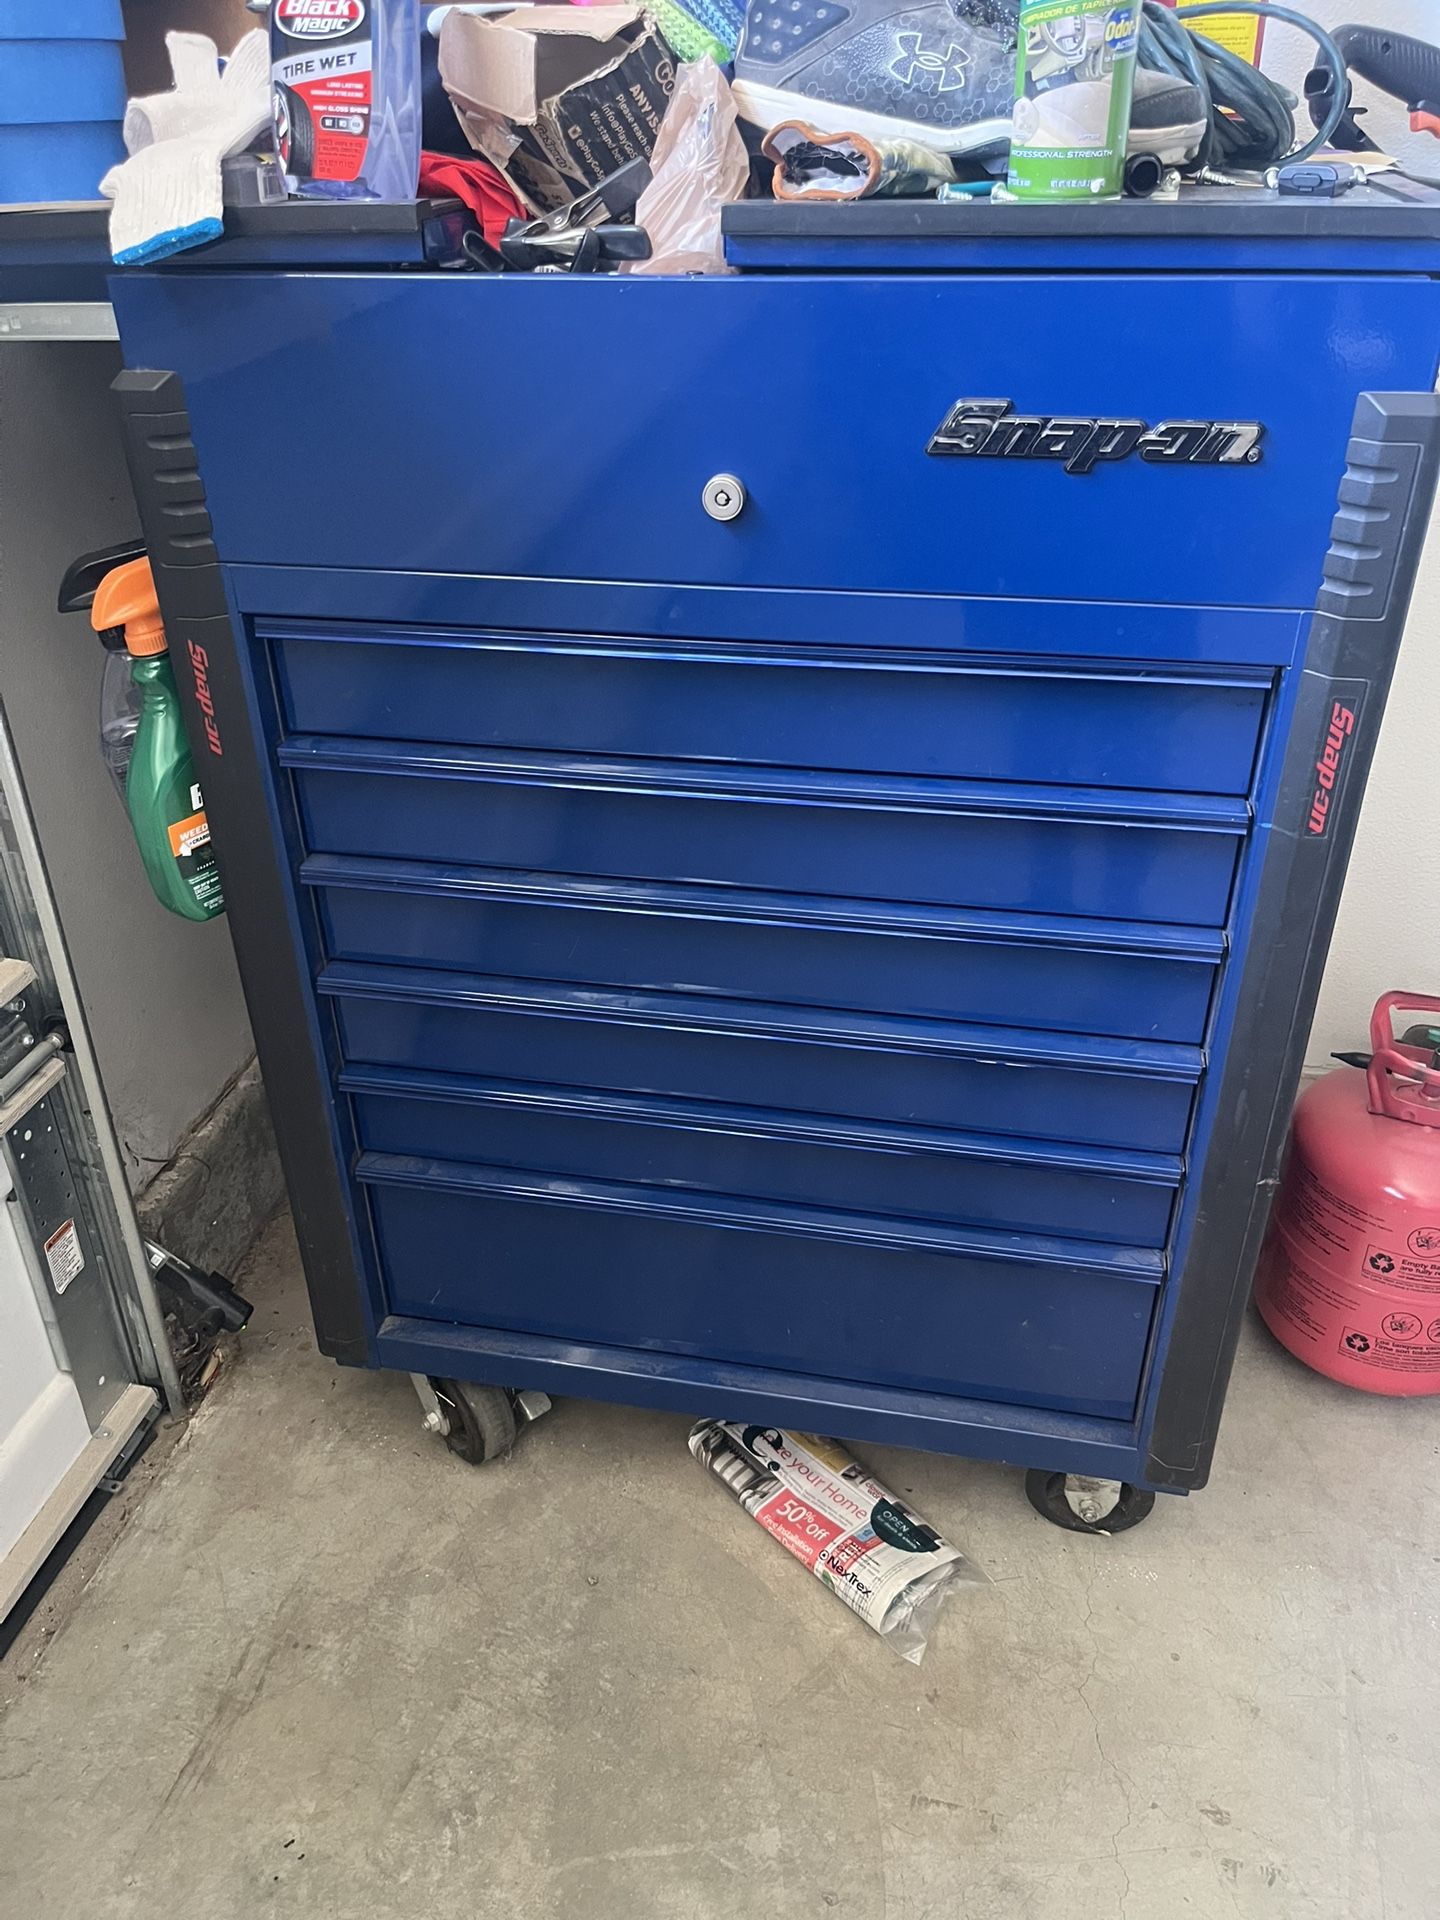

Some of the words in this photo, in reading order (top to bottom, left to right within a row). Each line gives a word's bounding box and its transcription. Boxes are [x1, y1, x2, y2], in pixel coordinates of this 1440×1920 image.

[285, 0, 352, 16] Black
[292, 17, 350, 32] Magic
[283, 60, 315, 79] TIRE
[319, 52, 357, 71] WET
[629, 84, 652, 113] ANY
[591, 110, 602, 126] We
[597, 124, 616, 150] stand
[616, 93, 635, 123] Please
[631, 121, 648, 147] reach
[1011, 149, 1064, 158] ROFESSIONAL
[1067, 149, 1113, 158] STRENGTH
[188, 639, 222, 755] Snap-on
[1308, 702, 1355, 834] Snap-on
[180, 822, 209, 841] WEED
[1401, 1258, 1429, 1270] Empty
[1415, 1268, 1433, 1276] fully
[786, 1458, 826, 1487] your
[821, 1483, 868, 1519] Home
[775, 1499, 816, 1523] 50%
[805, 1523, 830, 1541] Off
[882, 1510, 910, 1533] OPEN
[826, 1556, 872, 1598] NexTrex
